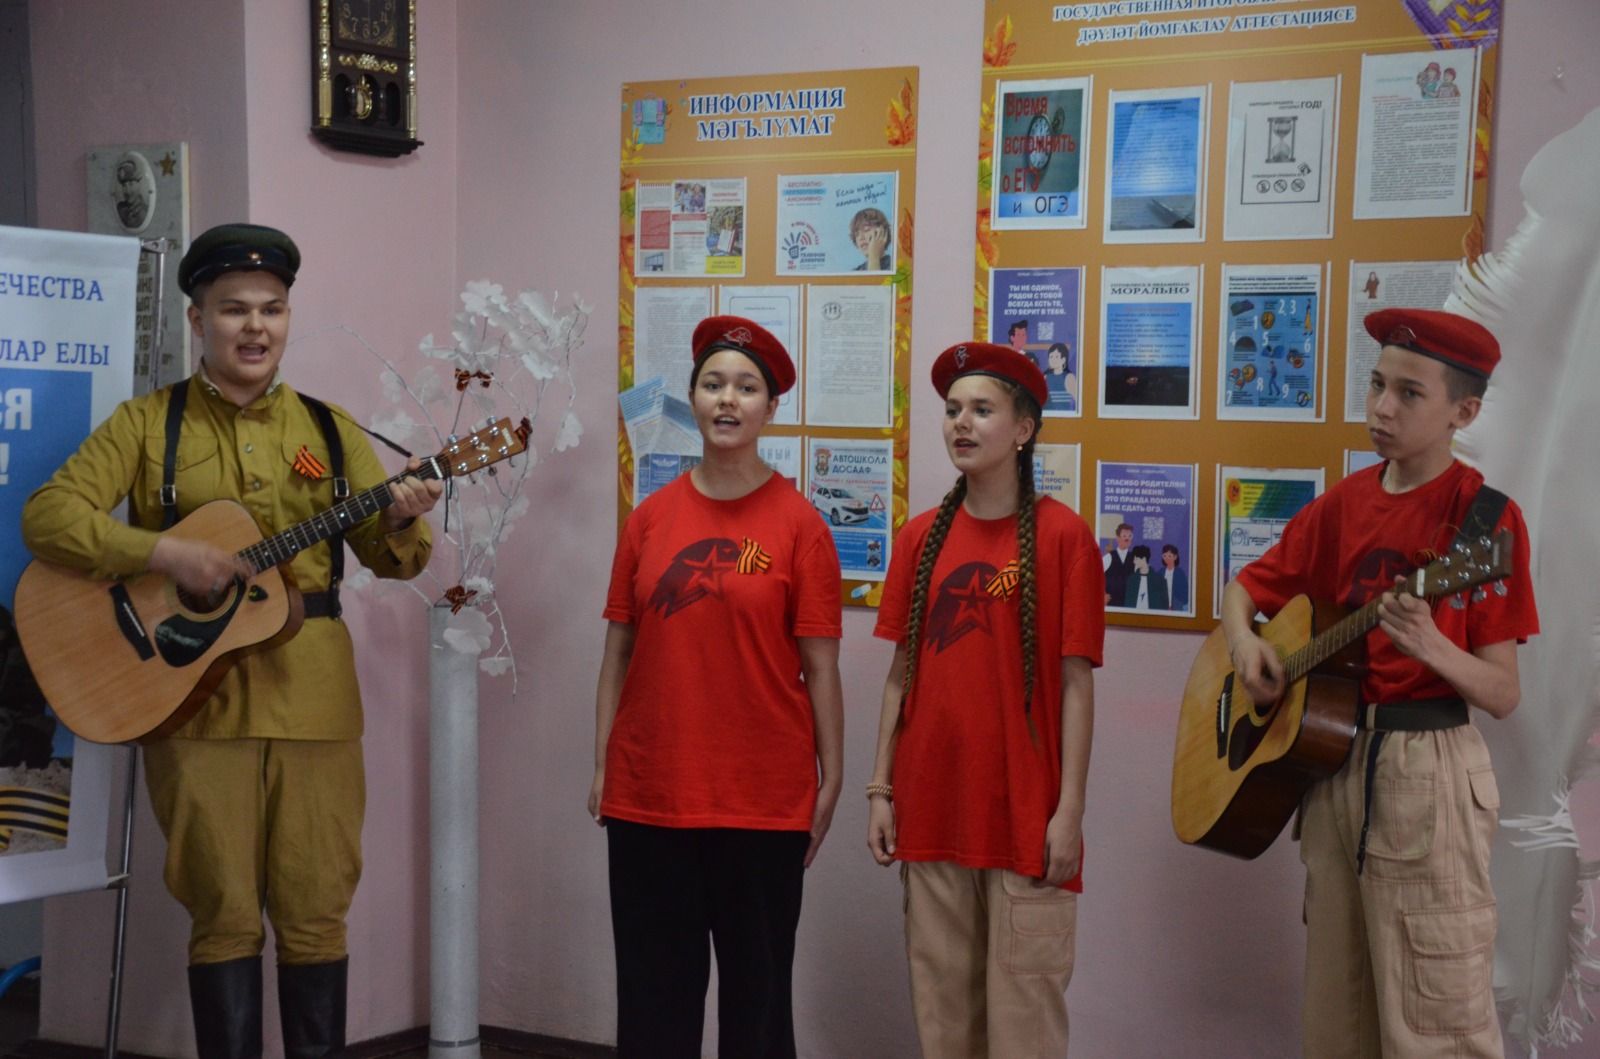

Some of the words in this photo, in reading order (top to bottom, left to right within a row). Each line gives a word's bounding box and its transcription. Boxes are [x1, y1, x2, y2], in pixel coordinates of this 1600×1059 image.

[1055, 0, 1192, 20] ГОСУДАРСТВЕННАЯ
[1139, 18, 1229, 38] ЙОМГАКЛАУ
[1232, 8, 1355, 31] АТТЕСТАЦИЯСЕ
[690, 88, 845, 115] ИНФОРМАЦИЯ
[1014, 167, 1040, 192] ЕГЭ
[1013, 201, 1022, 214] и
[1035, 195, 1068, 213] ОГЭ
[1110, 287, 1190, 295] МОРАЛЬНО
[1289, 299, 1297, 315] 3
[1262, 331, 1269, 347] 5
[56, 342, 110, 366] ЕЛЫ
[0, 388, 32, 431] Я
[832, 454, 887, 464] АВТОШКОЛА
[832, 464, 871, 474] ДОСААФ
[1105, 479, 1139, 487] СПАСИБО
